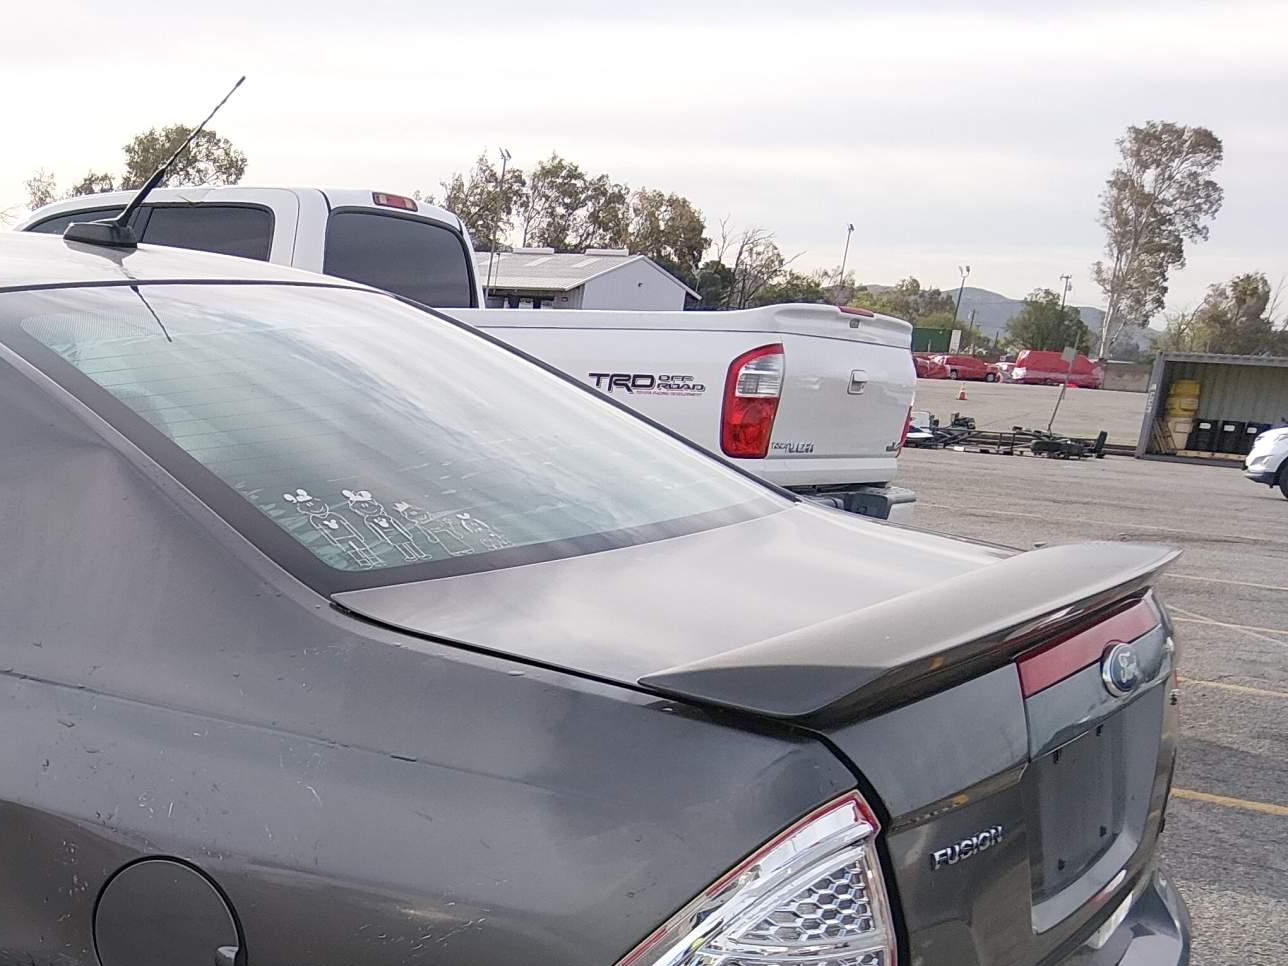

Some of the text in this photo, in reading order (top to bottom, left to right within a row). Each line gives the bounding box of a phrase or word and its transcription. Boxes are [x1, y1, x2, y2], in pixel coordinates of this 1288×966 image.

[588, 372, 656, 394] TRD
[658, 374, 695, 382] OFF
[657, 382, 706, 392] ROAD
[929, 824, 1003, 870] FUSION
